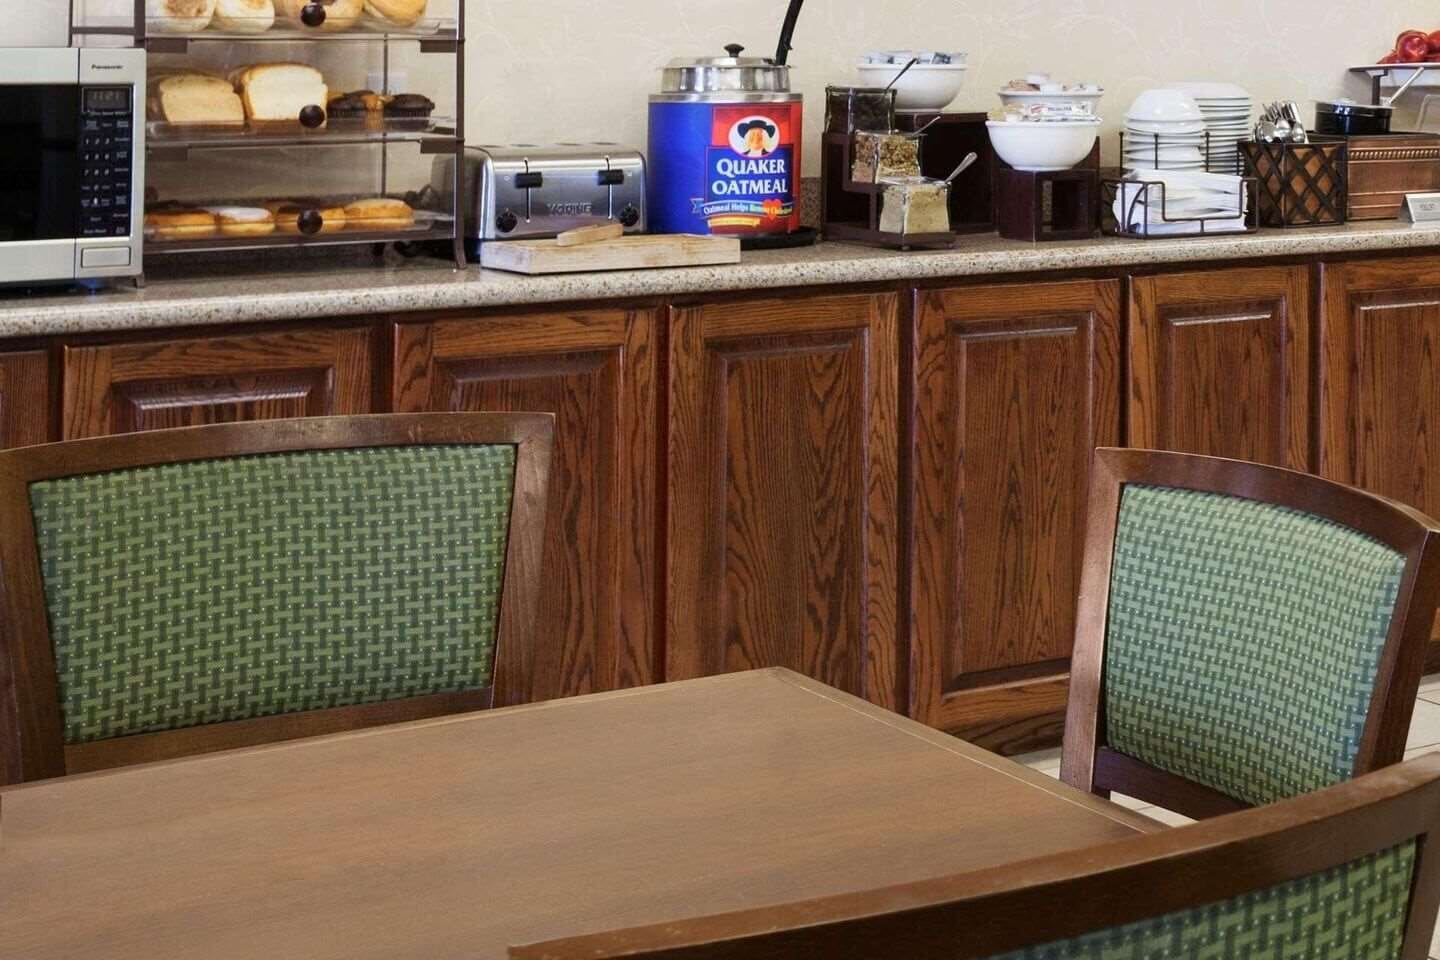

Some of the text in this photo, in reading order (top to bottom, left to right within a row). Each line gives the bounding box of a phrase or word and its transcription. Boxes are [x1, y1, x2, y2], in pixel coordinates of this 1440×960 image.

[716, 158, 786, 178] QUAKER
[711, 178, 788, 195] OATMEAL
[703, 202, 730, 215] Oatmeal
